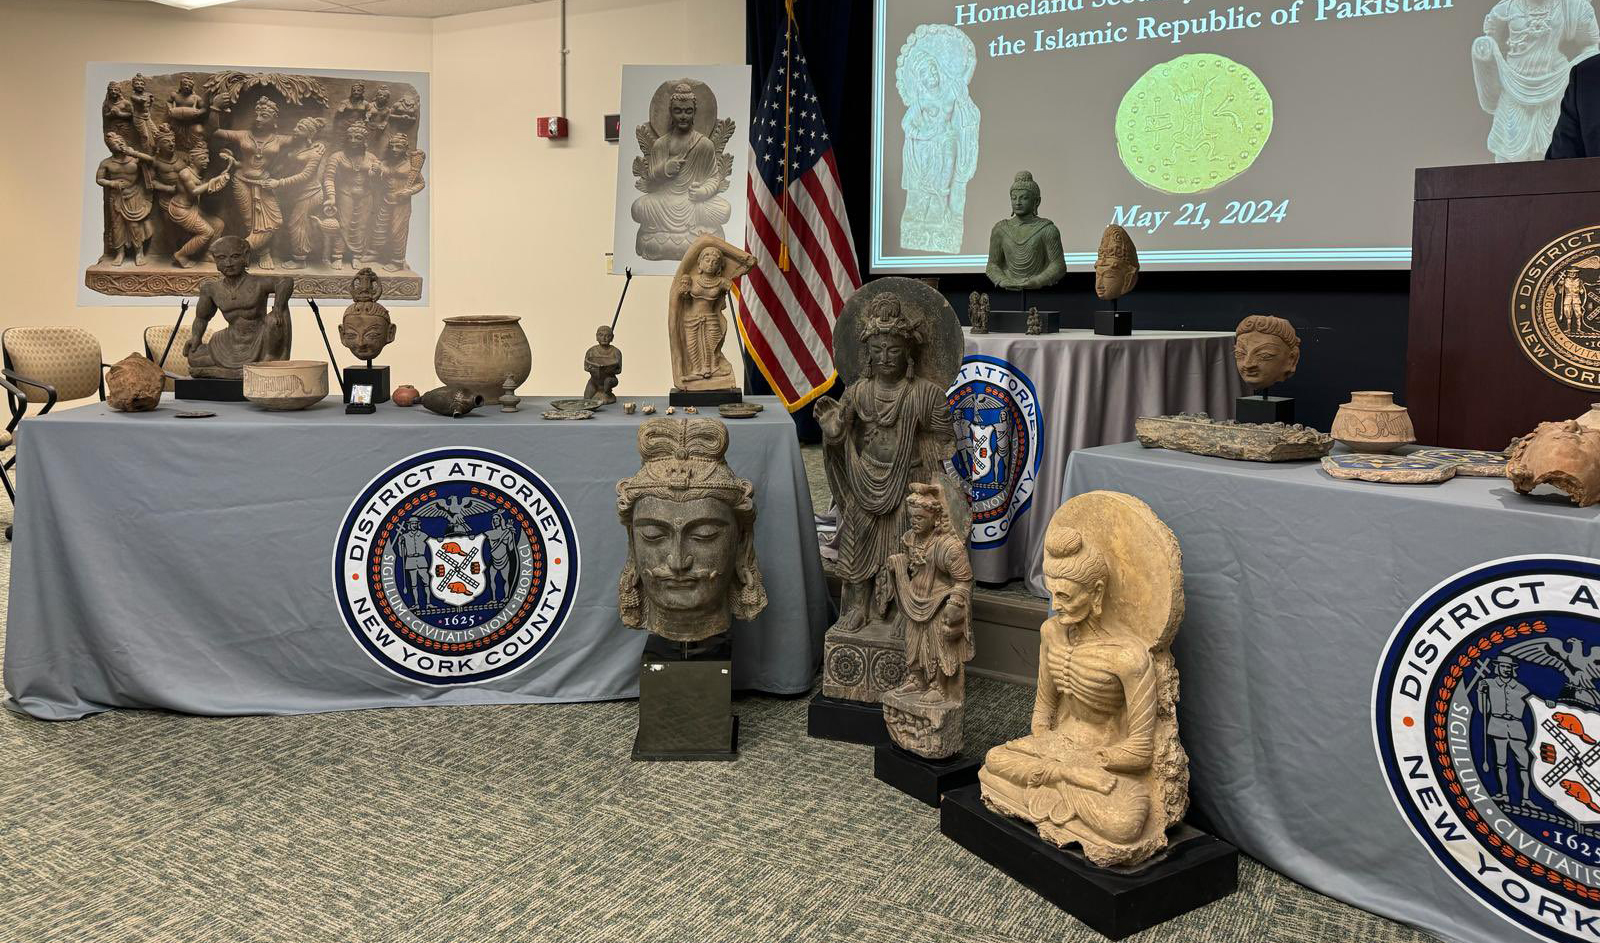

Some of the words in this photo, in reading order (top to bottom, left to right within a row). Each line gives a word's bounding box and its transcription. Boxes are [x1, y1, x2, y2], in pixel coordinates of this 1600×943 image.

[988, 36, 1026, 57] the
[1033, 21, 1128, 52] Islamic
[1136, 6, 1262, 44] Republic
[1270, 0, 1302, 26] of
[1315, 0, 1455, 21] Pakistan
[1107, 204, 1170, 234] May
[1173, 202, 1211, 230] 21,
[1219, 199, 1290, 224] 2024
[1519, 231, 1595, 297] DISTRICT
[1519, 320, 1550, 358] NEW
[1553, 358, 1600, 383] YOR
[1544, 292, 1562, 337] SIGILLUM
[975, 365, 1036, 440] ATTORNE
[349, 465, 436, 562] DISTRICT
[448, 462, 563, 545] ATTORNEY
[353, 595, 397, 648] NEW
[402, 645, 474, 673] YORK
[484, 579, 563, 666] COUNTY
[382, 554, 407, 617] SIGILLUM
[410, 619, 475, 643] CIVITATIS
[480, 609, 515, 636] NOVI
[514, 543, 531, 603] EBORACI
[444, 614, 475, 626] 1625
[1399, 581, 1545, 702] DISTRICT
[1449, 702, 1489, 805] SIGILLUM
[1494, 818, 1600, 886] CIVITATIS
[1402, 753, 1469, 844] NEW
[1476, 850, 1600, 938] YORK
